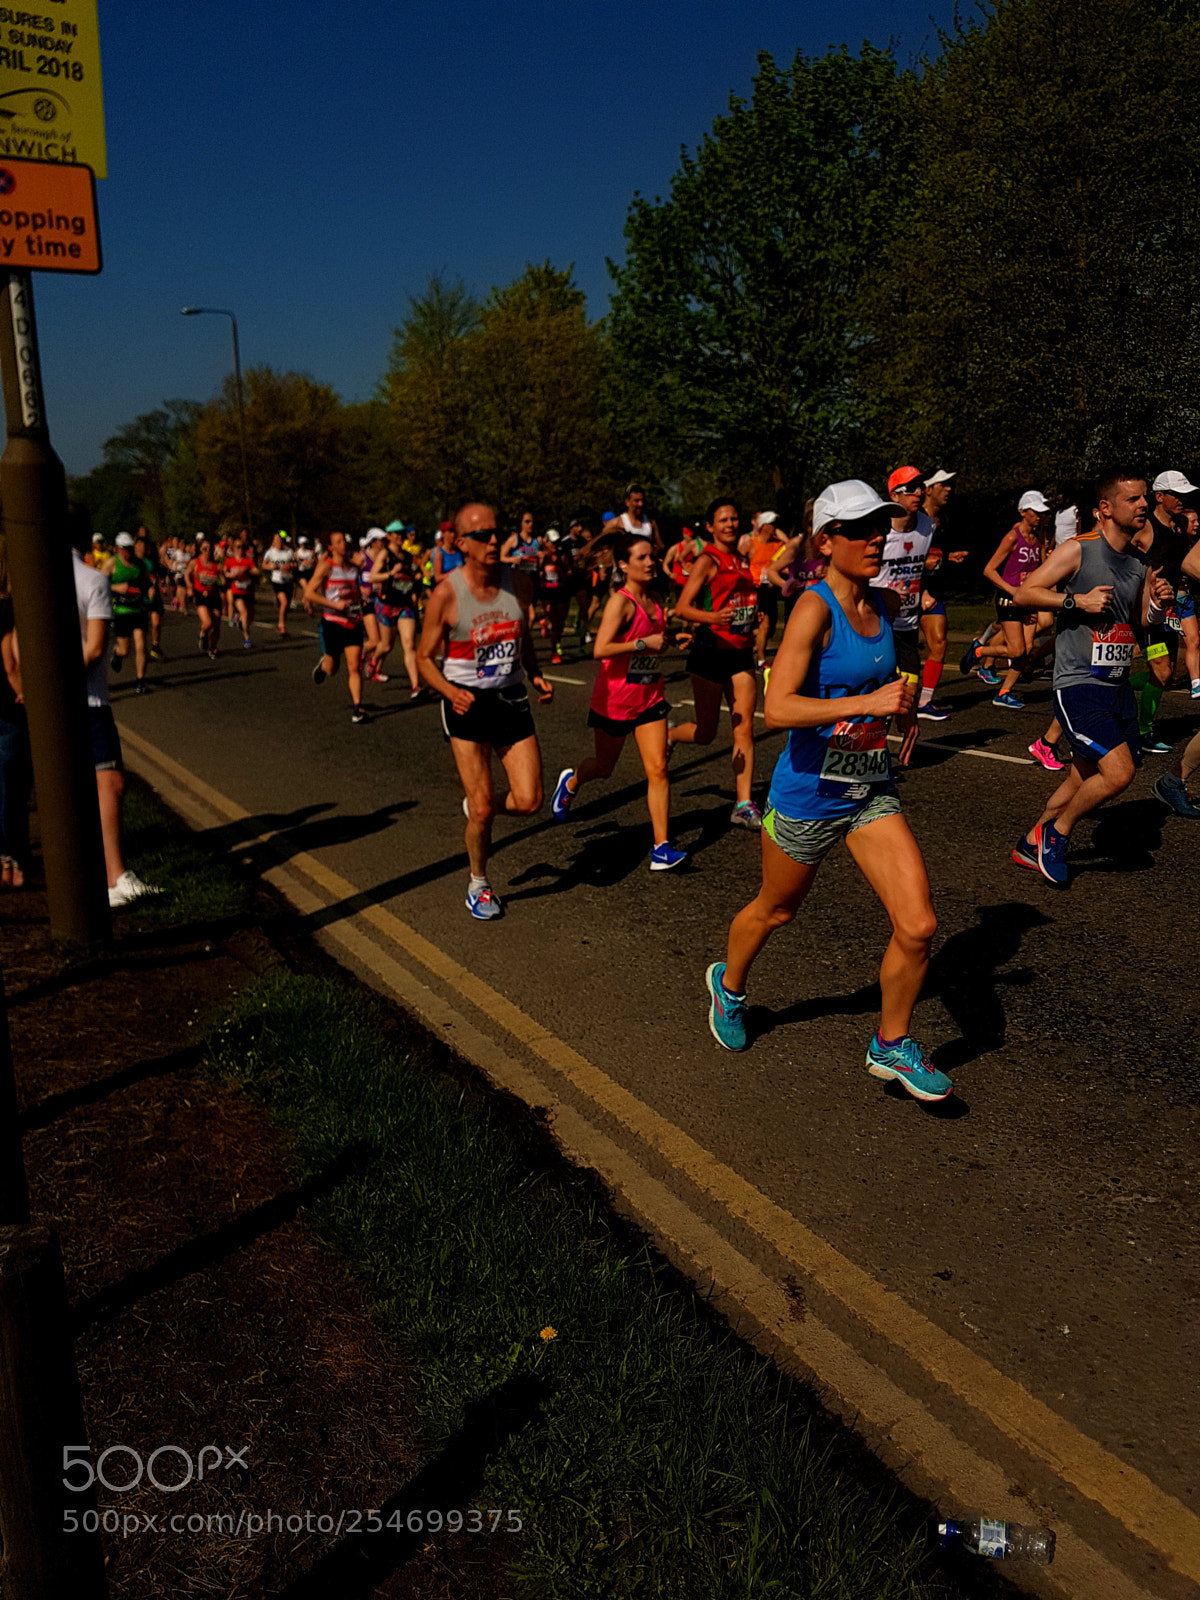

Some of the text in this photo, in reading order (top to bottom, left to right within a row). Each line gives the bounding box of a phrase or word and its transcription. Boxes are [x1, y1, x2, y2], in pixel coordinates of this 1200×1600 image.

[8, 28, 74, 55] SUNDAY
[61, 20, 78, 38] IN
[36, 54, 84, 82] 2018
[0, 208, 85, 236] opping
[26, 234, 82, 258] time
[1095, 643, 1134, 662] 18354
[825, 750, 888, 777] 28348
